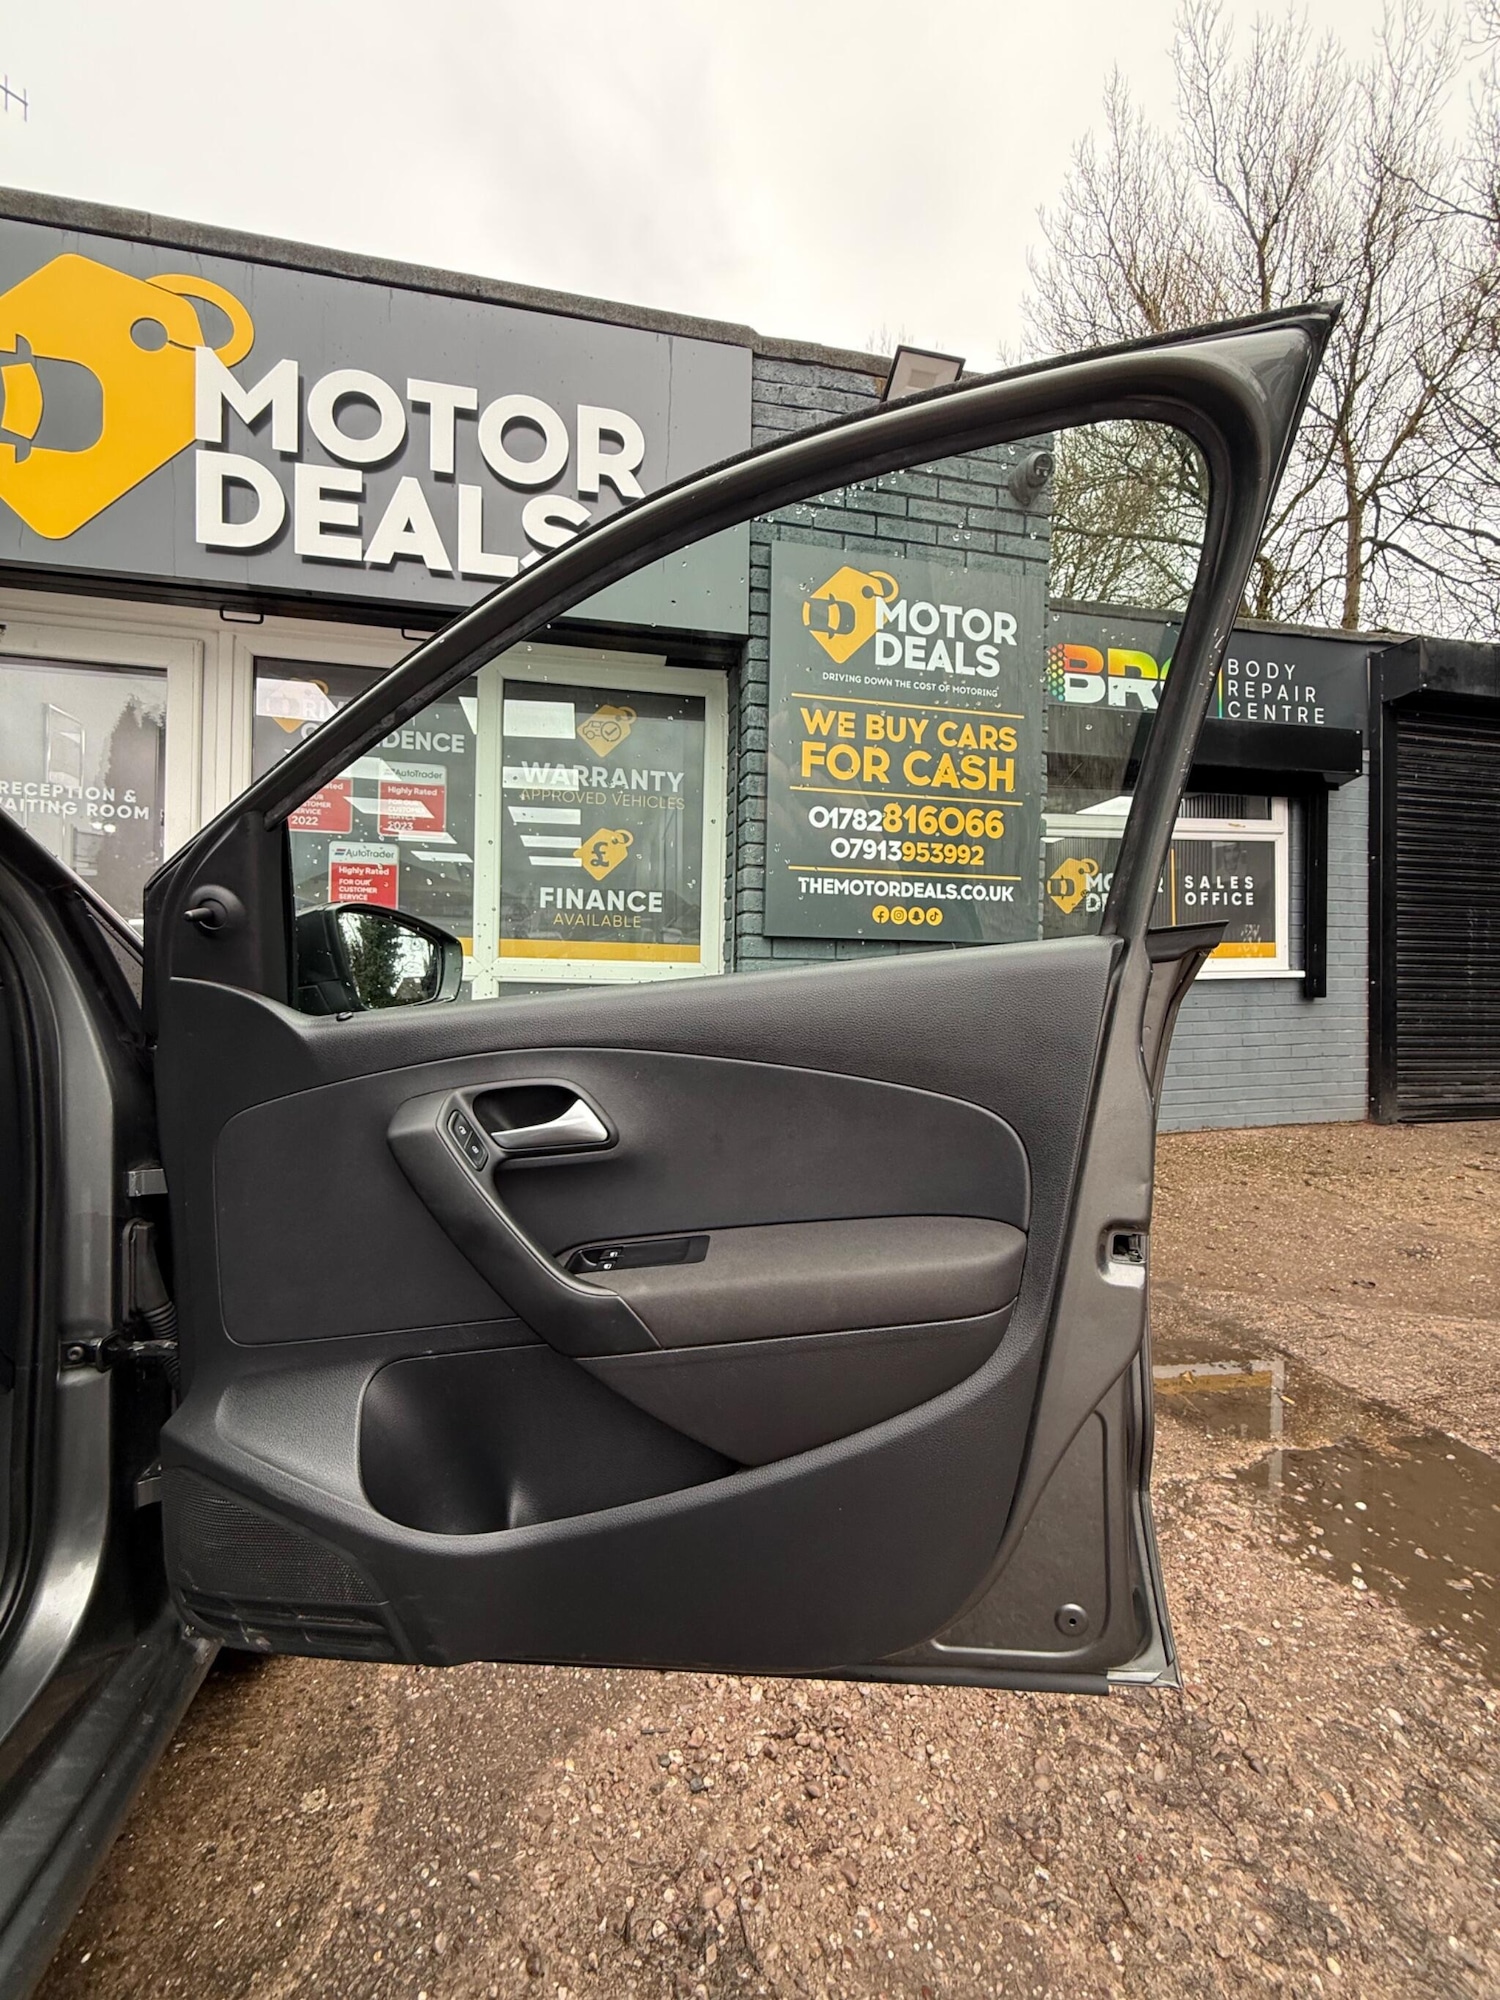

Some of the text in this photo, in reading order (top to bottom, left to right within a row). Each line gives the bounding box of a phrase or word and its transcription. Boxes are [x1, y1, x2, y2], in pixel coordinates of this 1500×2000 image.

[195, 346, 646, 500] MOTOR
[875, 596, 1018, 646] MOTOR
[875, 632, 1000, 678] DEALS
[1063, 644, 1172, 710] BR
[1228, 658, 1297, 680] BODY
[822, 671, 998, 698] DRIVING DOWN THE COST OF MOTORING
[1228, 680, 1316, 703] REPAIR
[1228, 702, 1325, 725] CENTRE
[800, 707, 1018, 753] WE BUY CARS
[521, 761, 684, 793] WARRANTY
[801, 741, 1015, 792] FOR CASH
[0, 780, 137, 803] RECEPTION &
[387, 785, 438, 796] Highly Rated
[521, 788, 686, 810] APPROVED VEHICLES
[0, 797, 149, 820] AITING ROOM
[291, 815, 319, 826] 2022
[387, 820, 414, 831] 2023
[808, 803, 1005, 839] 01782816066
[345, 848, 395, 859] AutoTrader
[830, 837, 984, 866] 07913953992
[338, 865, 390, 876] Highly Rated
[354, 878, 371, 886] OUR
[1184, 875, 1254, 889] SALES
[338, 885, 378, 894] CUSTOMER
[338, 893, 368, 901] SERVICE
[539, 886, 663, 913] FINANCE
[798, 876, 1014, 902] THEMOTORDEALS.CO.UK
[1184, 892, 1254, 906] OFFICE
[553, 912, 641, 928] AVAILABLE
